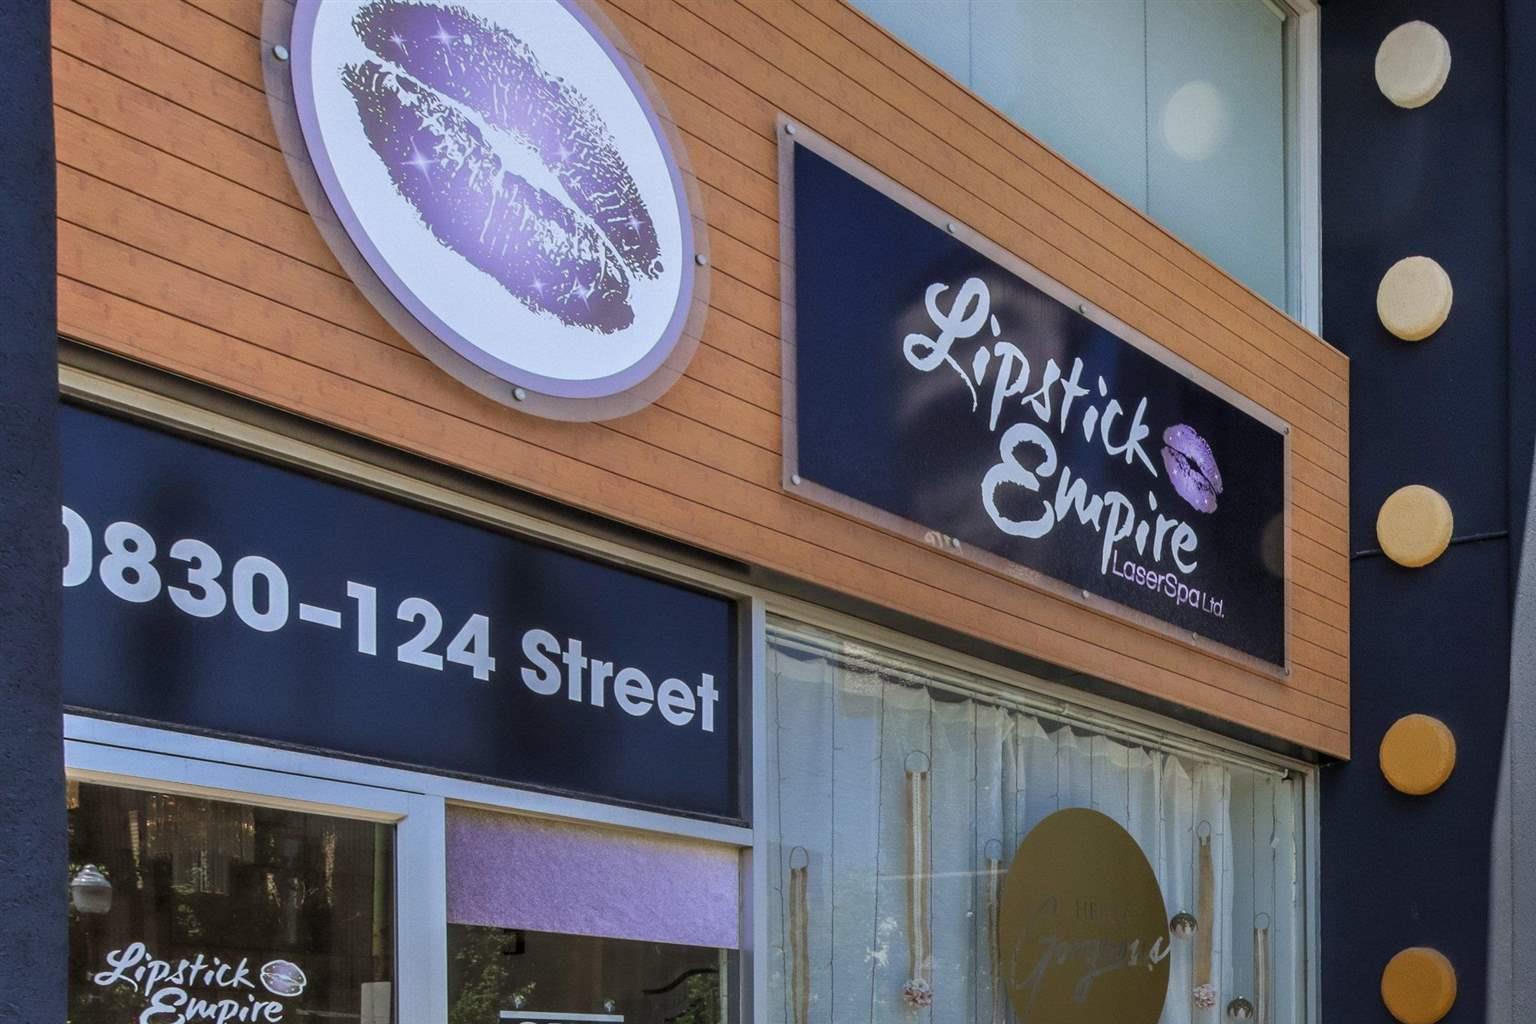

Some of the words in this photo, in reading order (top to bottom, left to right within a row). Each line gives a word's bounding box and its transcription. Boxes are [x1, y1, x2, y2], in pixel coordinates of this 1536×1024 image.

[903, 277, 1158, 477] Lipstick
[981, 422, 1198, 575] Empire
[1112, 550, 1200, 609] LaserSpa
[1202, 592, 1225, 619] Ltd.
[520, 628, 719, 732] Street
[94, 942, 255, 996] Lipstick
